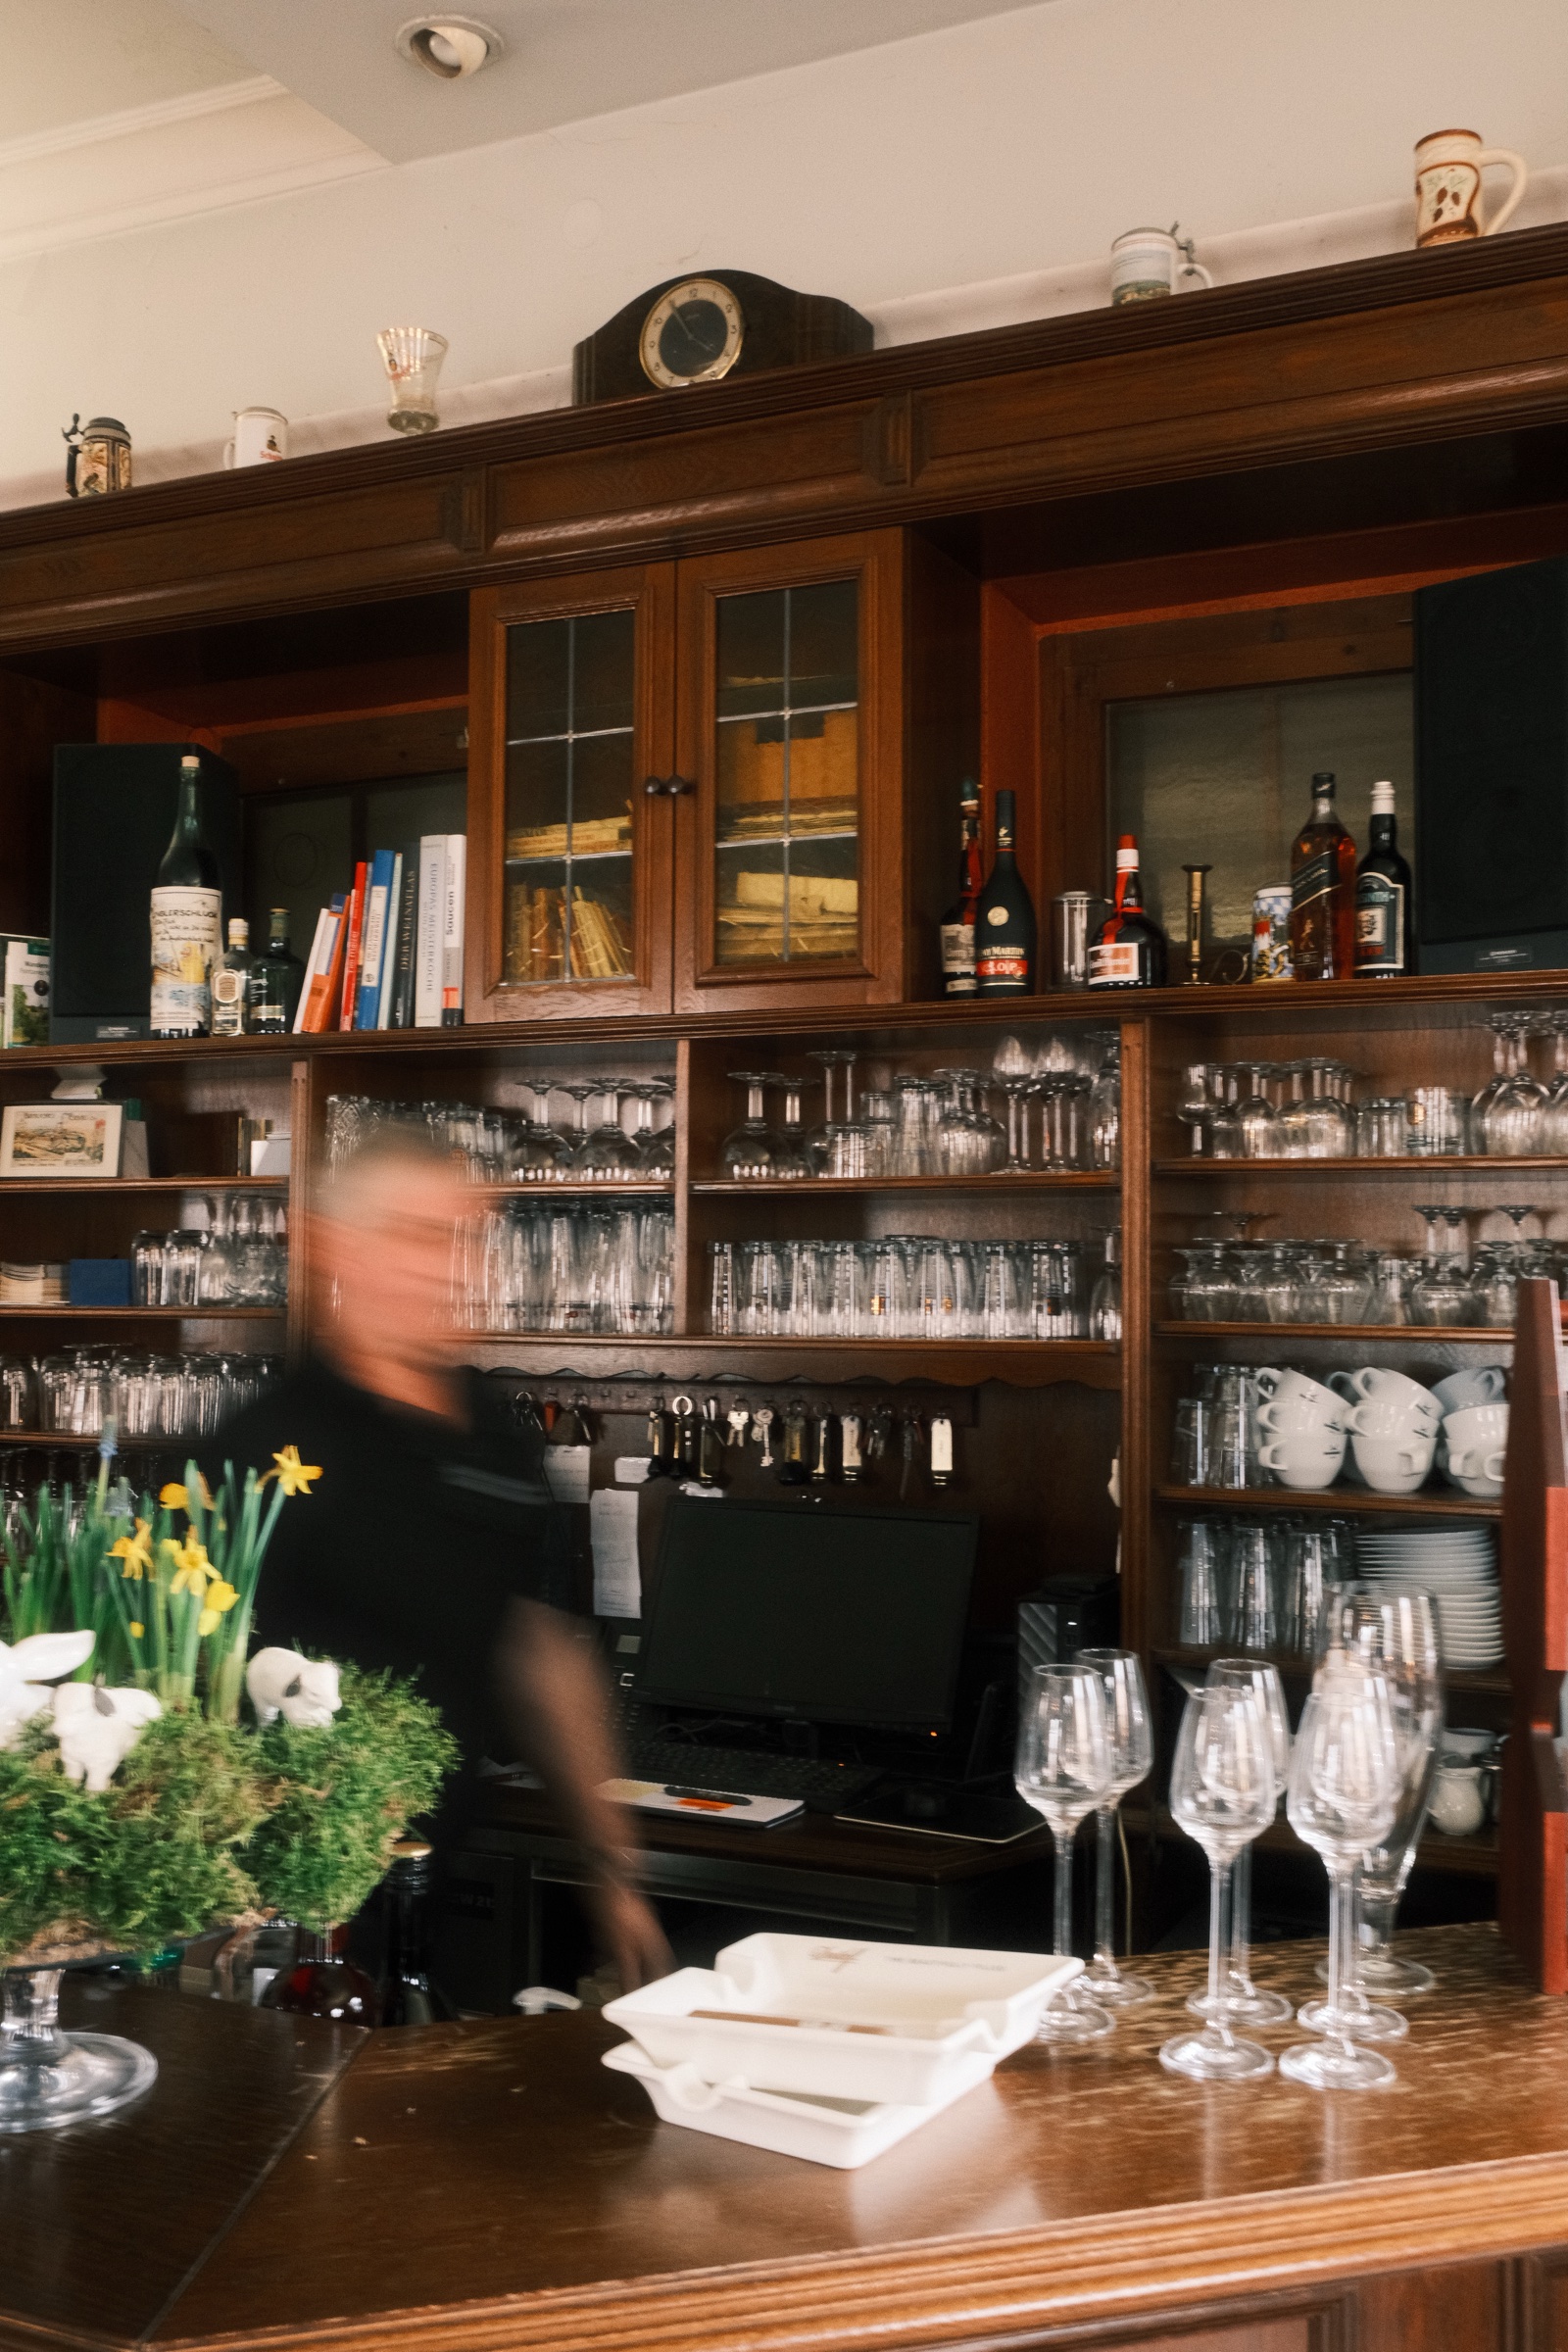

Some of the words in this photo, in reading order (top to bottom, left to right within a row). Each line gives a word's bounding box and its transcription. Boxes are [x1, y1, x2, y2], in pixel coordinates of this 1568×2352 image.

[725, 304, 733, 314] 2
[729, 324, 738, 334] 3
[402, 870, 416, 942] WEINATLAS
[446, 891, 455, 936] Saucen
[400, 945, 411, 971] DER
